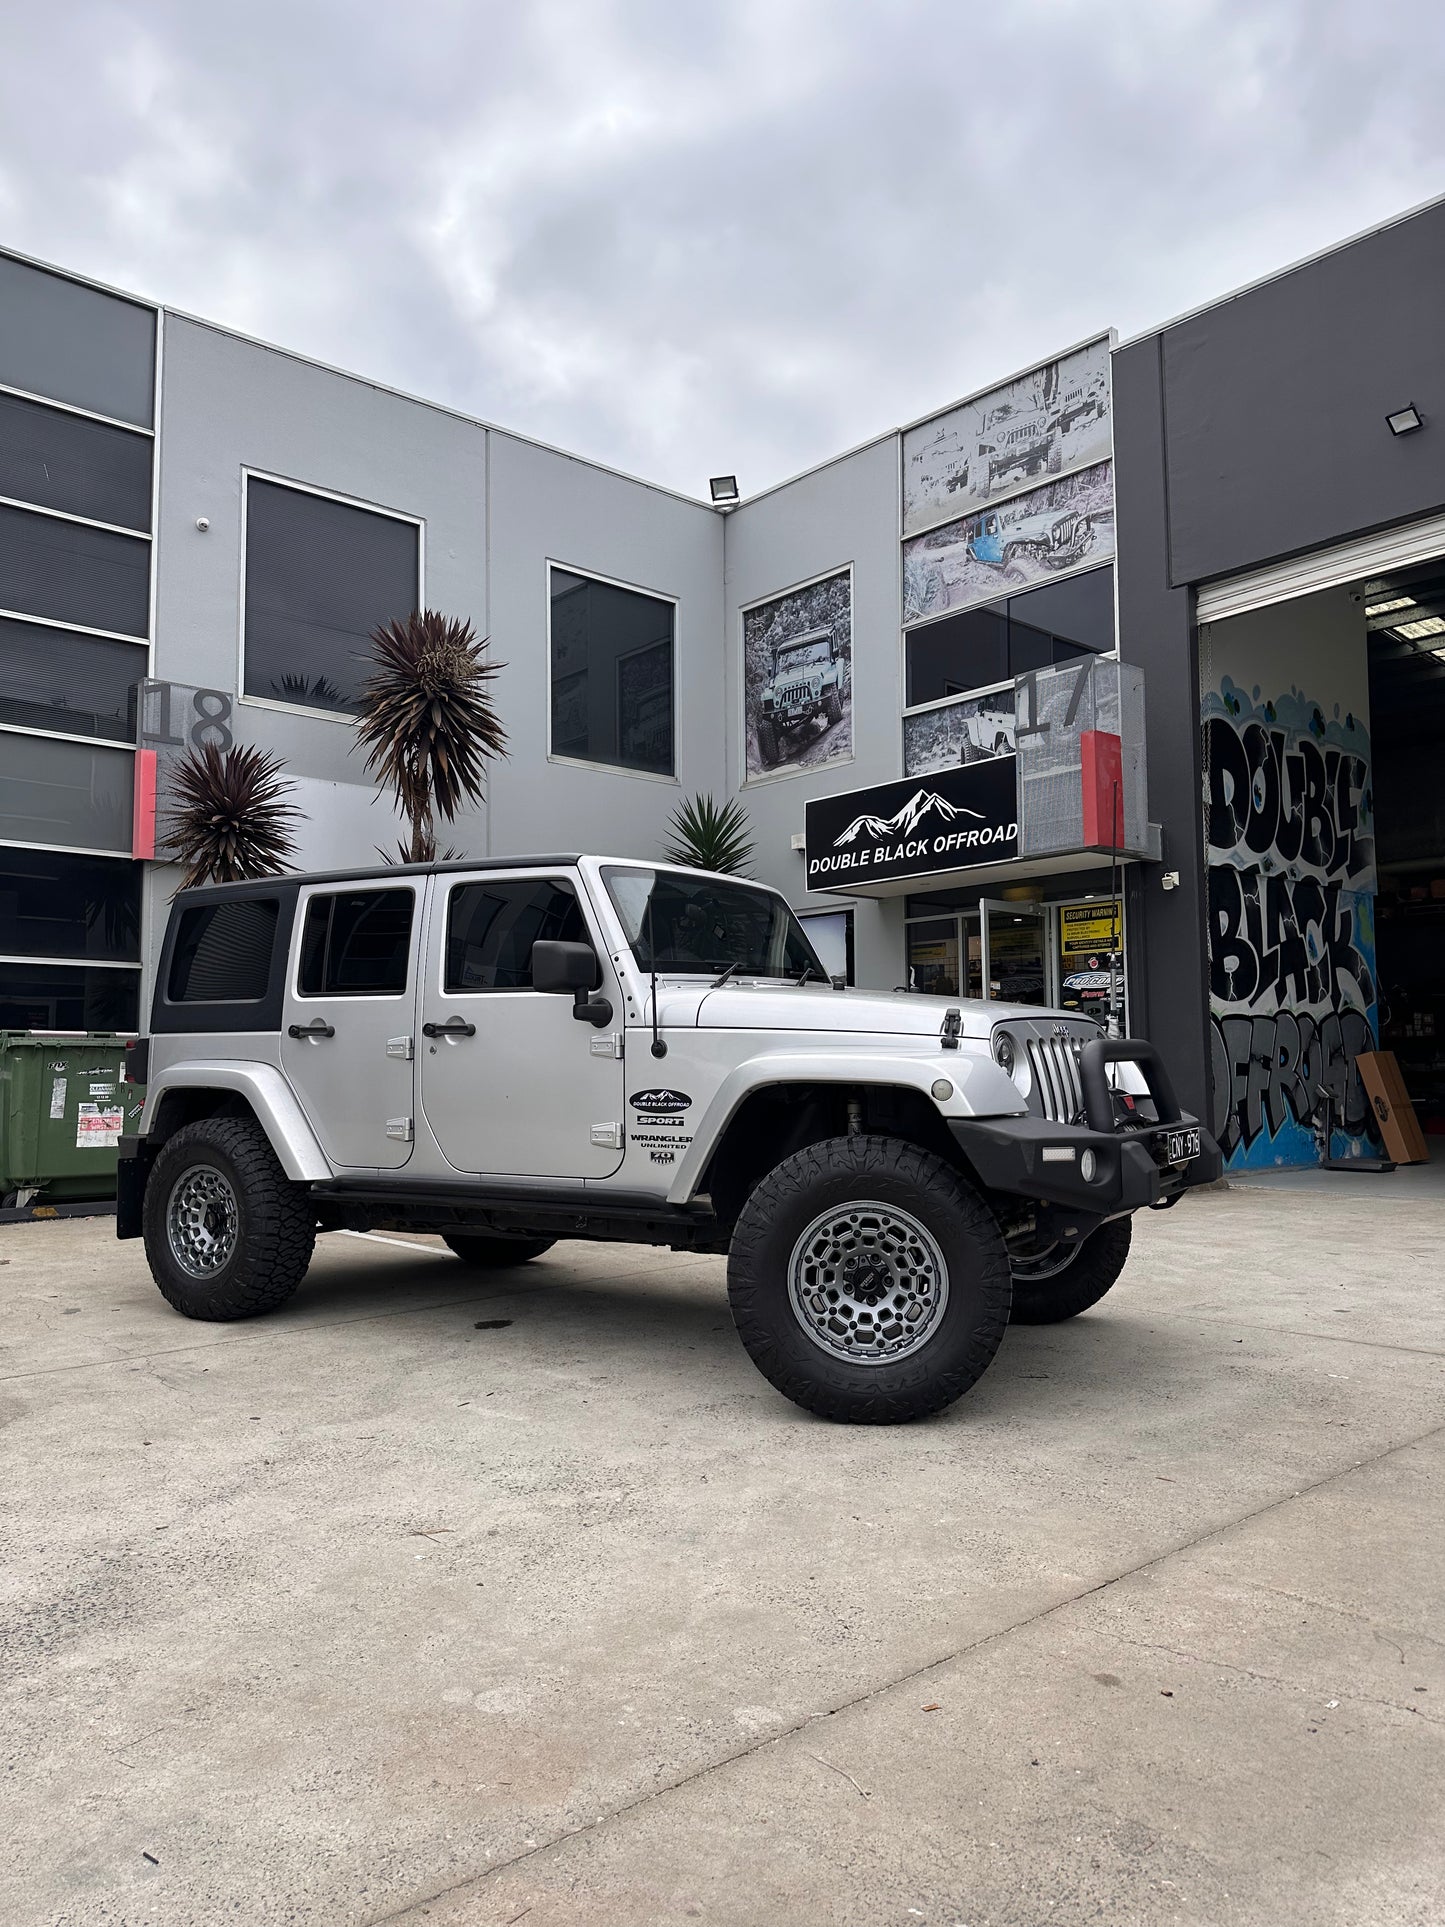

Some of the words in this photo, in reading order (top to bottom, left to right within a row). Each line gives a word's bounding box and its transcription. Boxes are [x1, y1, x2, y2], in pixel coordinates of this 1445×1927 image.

[142, 683, 233, 753] 18
[1014, 653, 1095, 738] 17
[1207, 717, 1375, 879] DOUBLE
[809, 849, 871, 874] DOUBLE
[873, 839, 930, 863] BLACK
[933, 822, 1019, 852] OFFROAD
[1066, 910, 1091, 920] SECURITY
[1208, 863, 1376, 1012] BLACK
[630, 1134, 693, 1142] WRANGLER
[639, 1117, 682, 1125] SPORT
